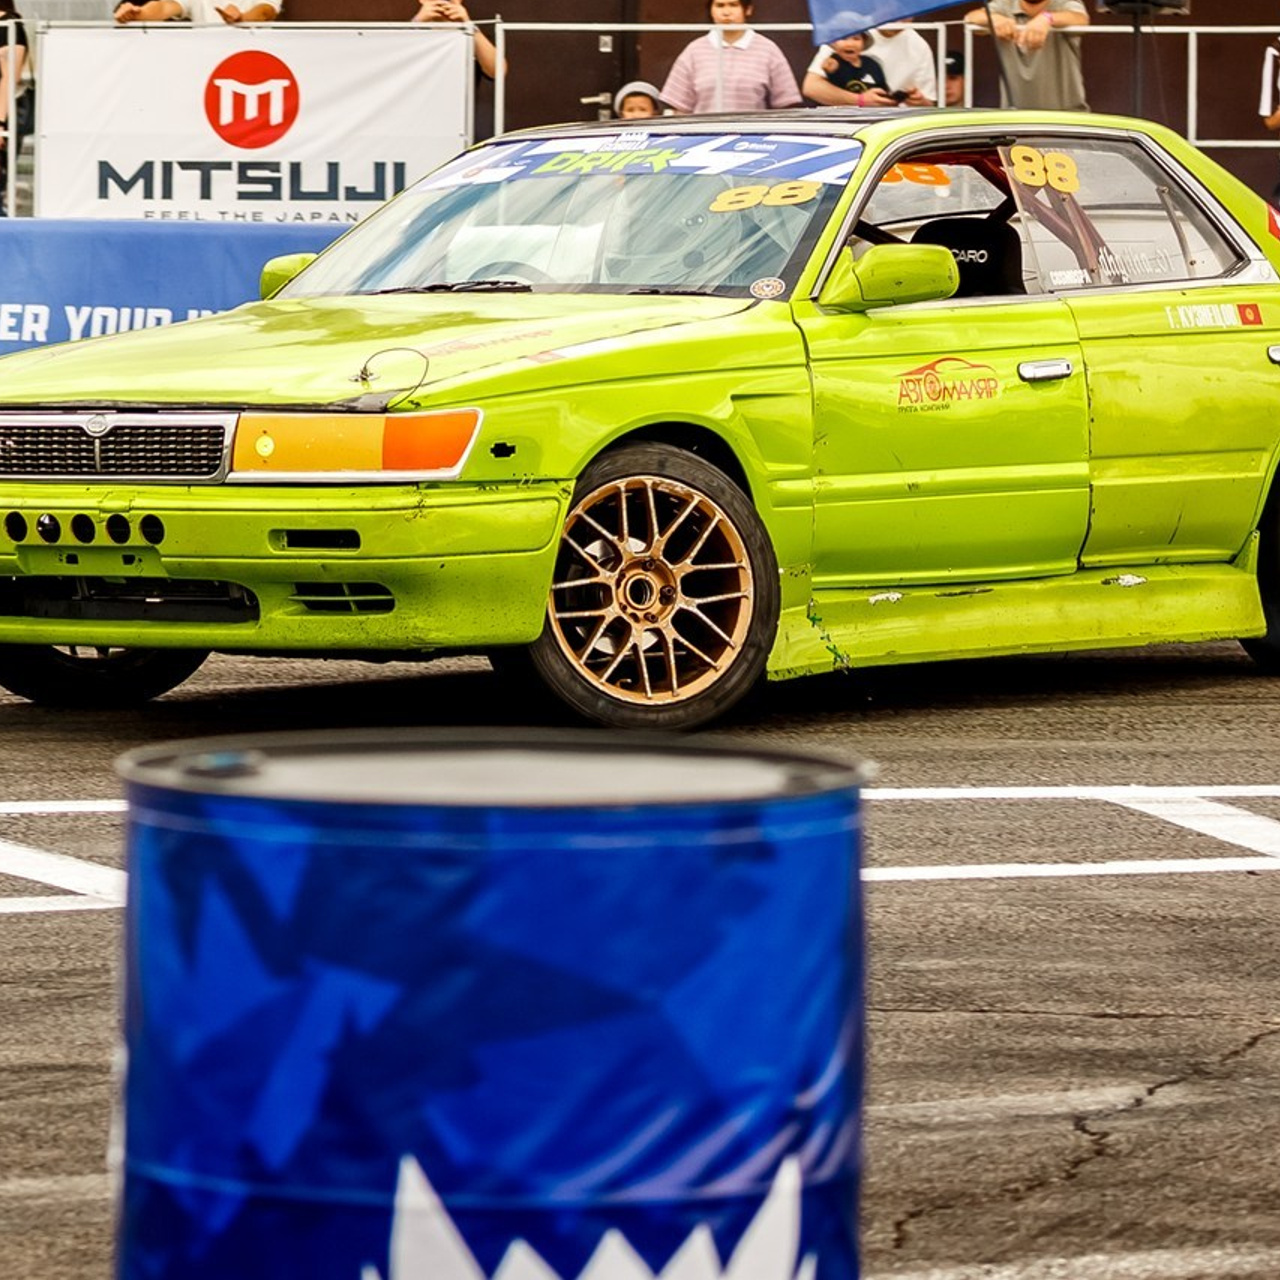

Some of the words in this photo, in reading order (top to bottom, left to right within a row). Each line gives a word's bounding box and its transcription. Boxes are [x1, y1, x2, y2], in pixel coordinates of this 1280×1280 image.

[532, 148, 686, 174] DRIFT
[1010, 145, 1080, 194] 88
[98, 160, 406, 201] MITSUJI
[709, 181, 821, 212] 88
[144, 211, 201, 221] FEEL
[218, 211, 264, 222] THE
[275, 211, 359, 222] JAPAN
